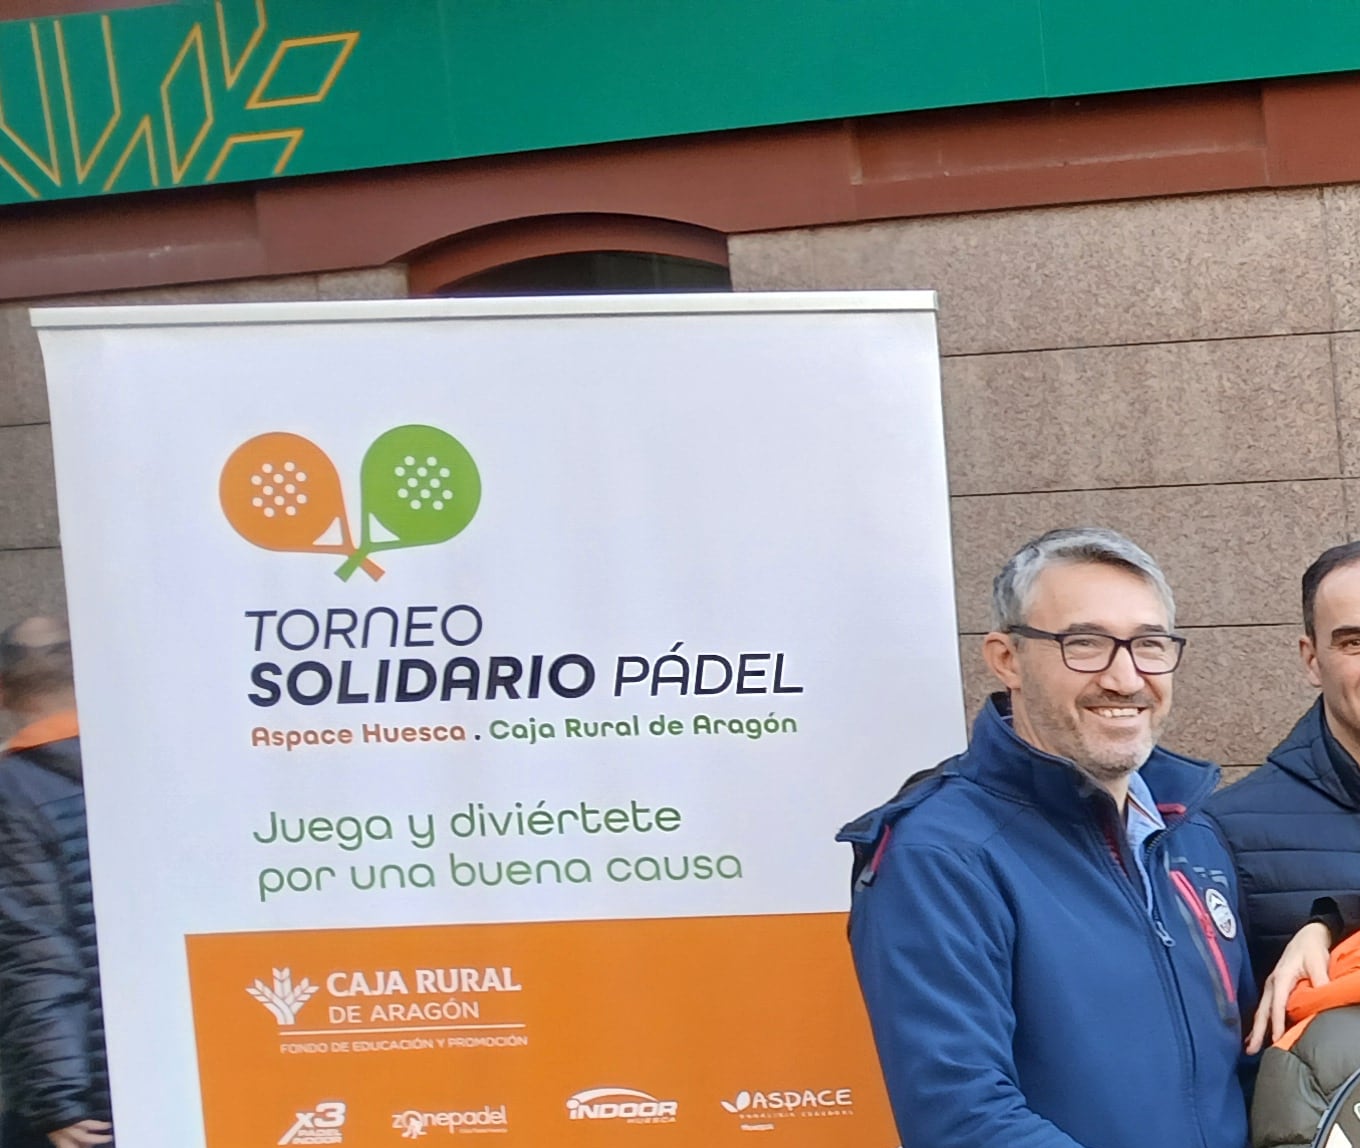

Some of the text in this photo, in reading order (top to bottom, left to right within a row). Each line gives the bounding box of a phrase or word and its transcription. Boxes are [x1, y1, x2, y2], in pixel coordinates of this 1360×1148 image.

[244, 603, 483, 652] TORNEO
[247, 641, 804, 708] SOLIDARIO PÁDEL
[250, 726, 353, 752] Aspace
[362, 721, 466, 744] Huesca
[488, 717, 556, 746] Caja
[564, 715, 640, 739] Rural
[649, 714, 684, 737] de
[692, 712, 798, 740] Aragón
[252, 801, 682, 852] Juega y diviértete
[257, 851, 744, 903] por una buena causa
[326, 967, 523, 998] CAJA RURAL
[328, 998, 480, 1024] DE ARAGÓN
[280, 1034, 529, 1054] FONDO DE EDUCACIÓN Y PROMOCIÓN
[752, 1088, 853, 1111] ASPACE
